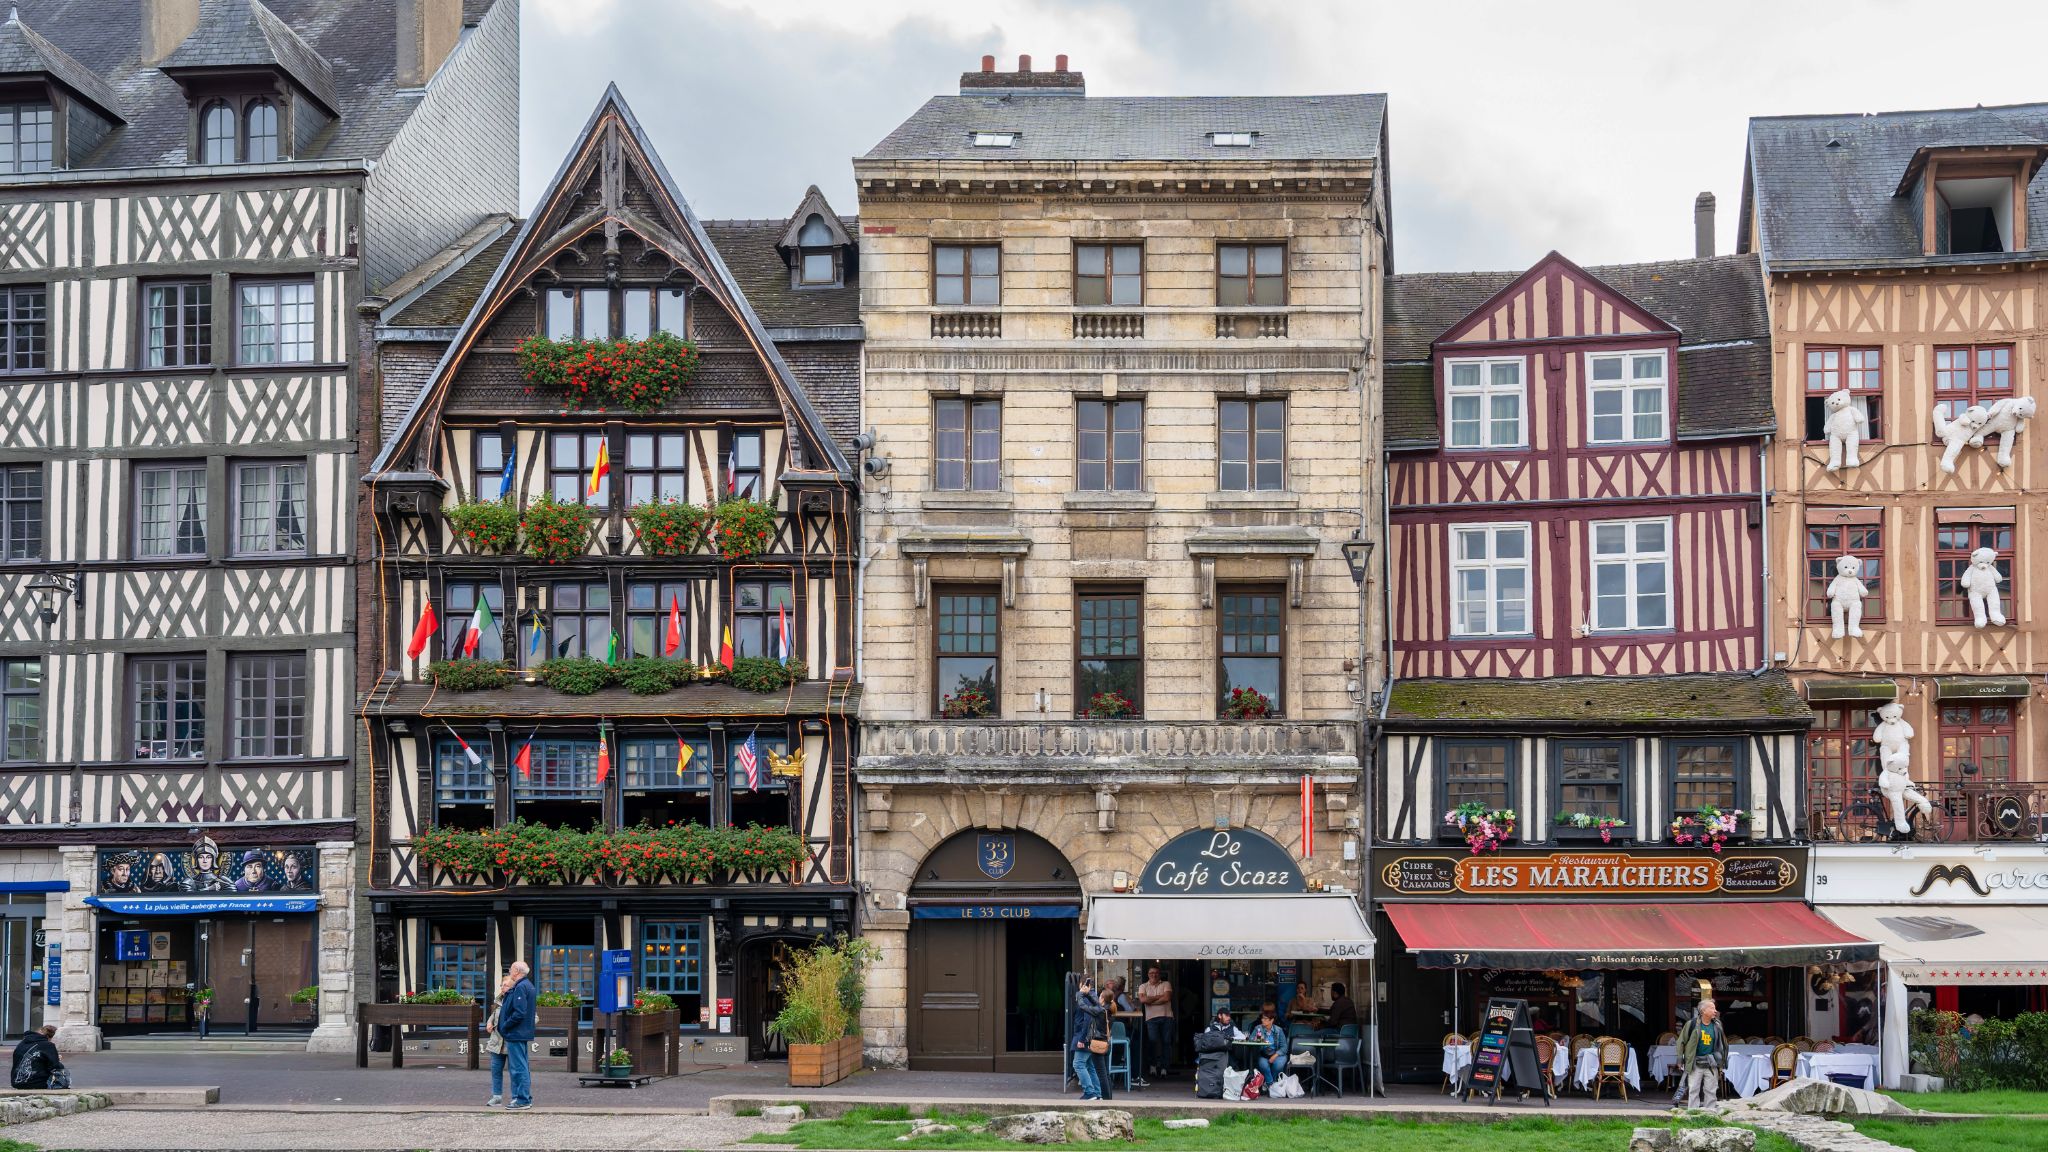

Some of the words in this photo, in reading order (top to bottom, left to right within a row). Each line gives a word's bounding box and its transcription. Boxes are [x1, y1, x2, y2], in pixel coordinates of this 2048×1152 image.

[1201, 832, 1241, 858] Le
[985, 842, 1008, 861] 33
[1558, 856, 1620, 865] Restaurant
[1403, 862, 1433, 870] CIDRE
[1155, 862, 1209, 892] Café
[1220, 861, 1289, 886] Scazz
[1403, 872, 1432, 880] VIEUX
[1470, 866, 1518, 887] LES
[1529, 866, 1709, 887] MARAICHERS
[1816, 876, 1828, 885] 39
[1402, 880, 1450, 888] CALVADOS
[1726, 877, 1776, 886] BEAUJOLAIS
[962, 908, 972, 918] LE
[979, 907, 994, 918] 33
[1001, 908, 1030, 918] CLUB
[1094, 945, 1119, 956] BAR
[1199, 945, 1213, 956] Le
[1216, 945, 1236, 956] Café
[1238, 945, 1263, 955] Scazz
[1323, 945, 1366, 956] TABAC
[1826, 950, 1842, 959] 37
[1453, 954, 1469, 964] 37
[1631, 955, 1664, 963] fondée
